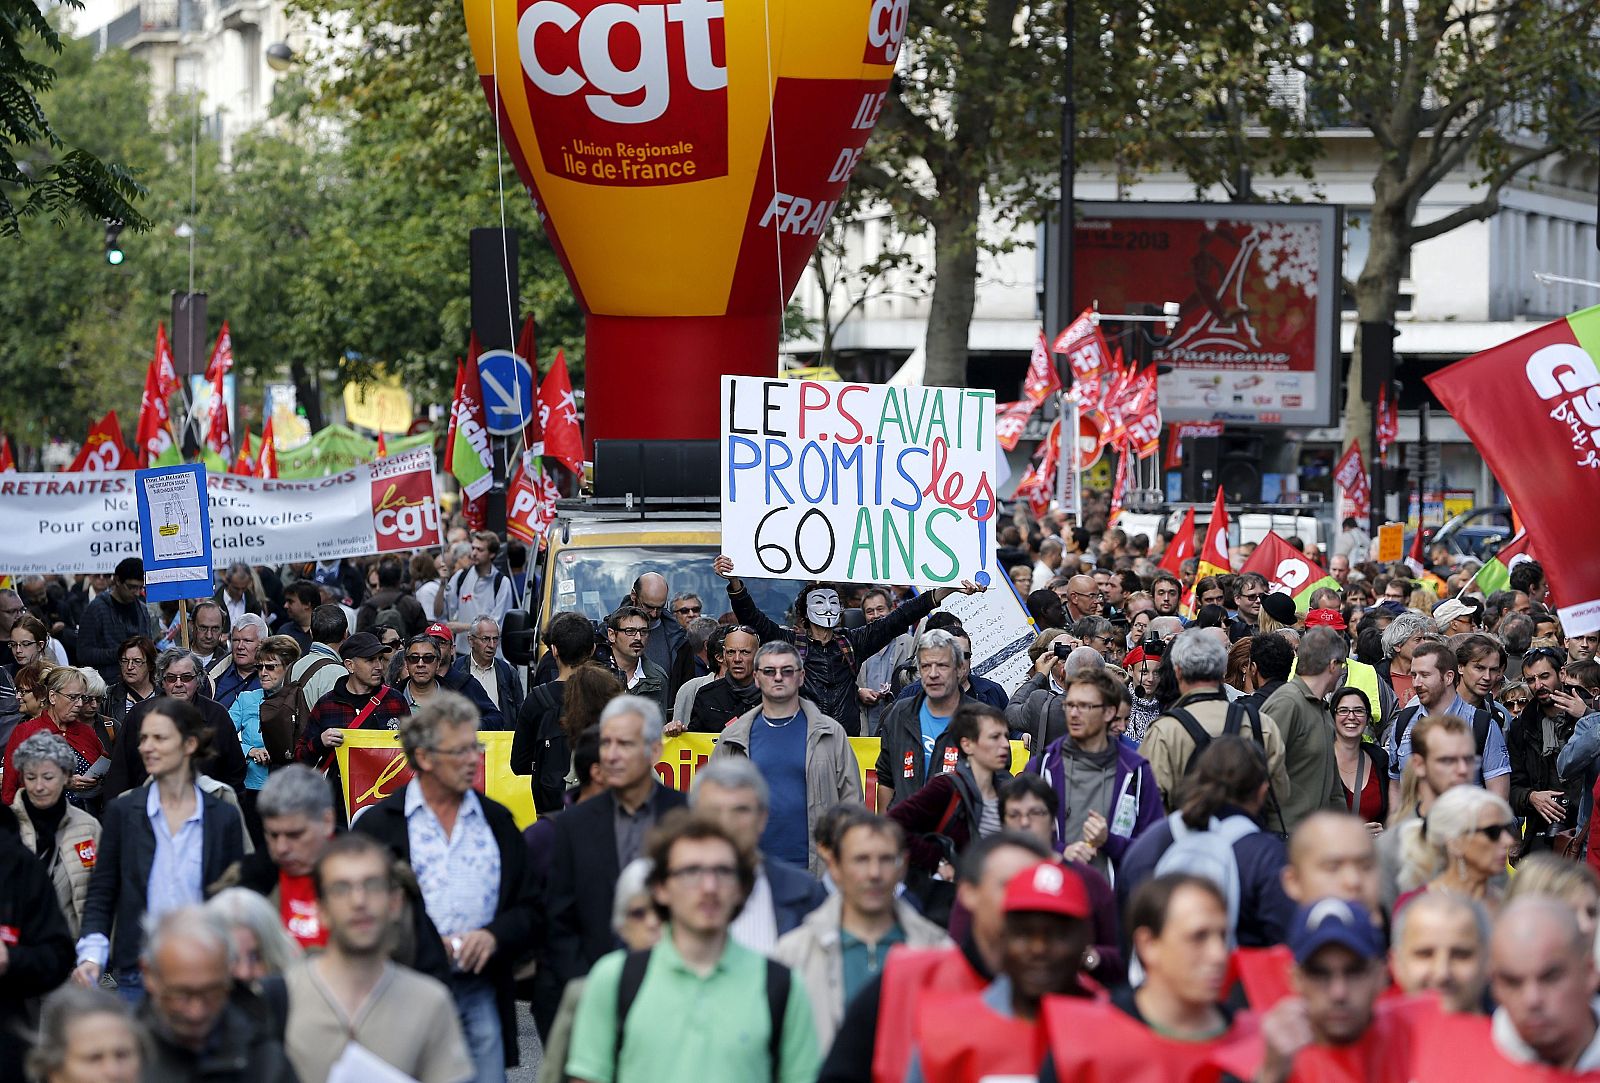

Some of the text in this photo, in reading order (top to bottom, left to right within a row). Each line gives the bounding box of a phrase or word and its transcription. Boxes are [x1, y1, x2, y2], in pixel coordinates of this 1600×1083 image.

[517, 0, 728, 124] cgt
[573, 138, 693, 162] Union Régionale
[729, 379, 788, 437] LE
[876, 386, 995, 451] AVAIT
[262, 470, 357, 492] EMPLOIS
[370, 460, 431, 478] d'études
[729, 435, 929, 511] PROMIS
[923, 436, 996, 522] les
[104, 497, 129, 512] Ne
[39, 520, 85, 534] Pour
[222, 511, 314, 528] nouvelles
[375, 495, 438, 542] cgt
[754, 506, 836, 574] 60
[943, 752, 959, 762] cgt
